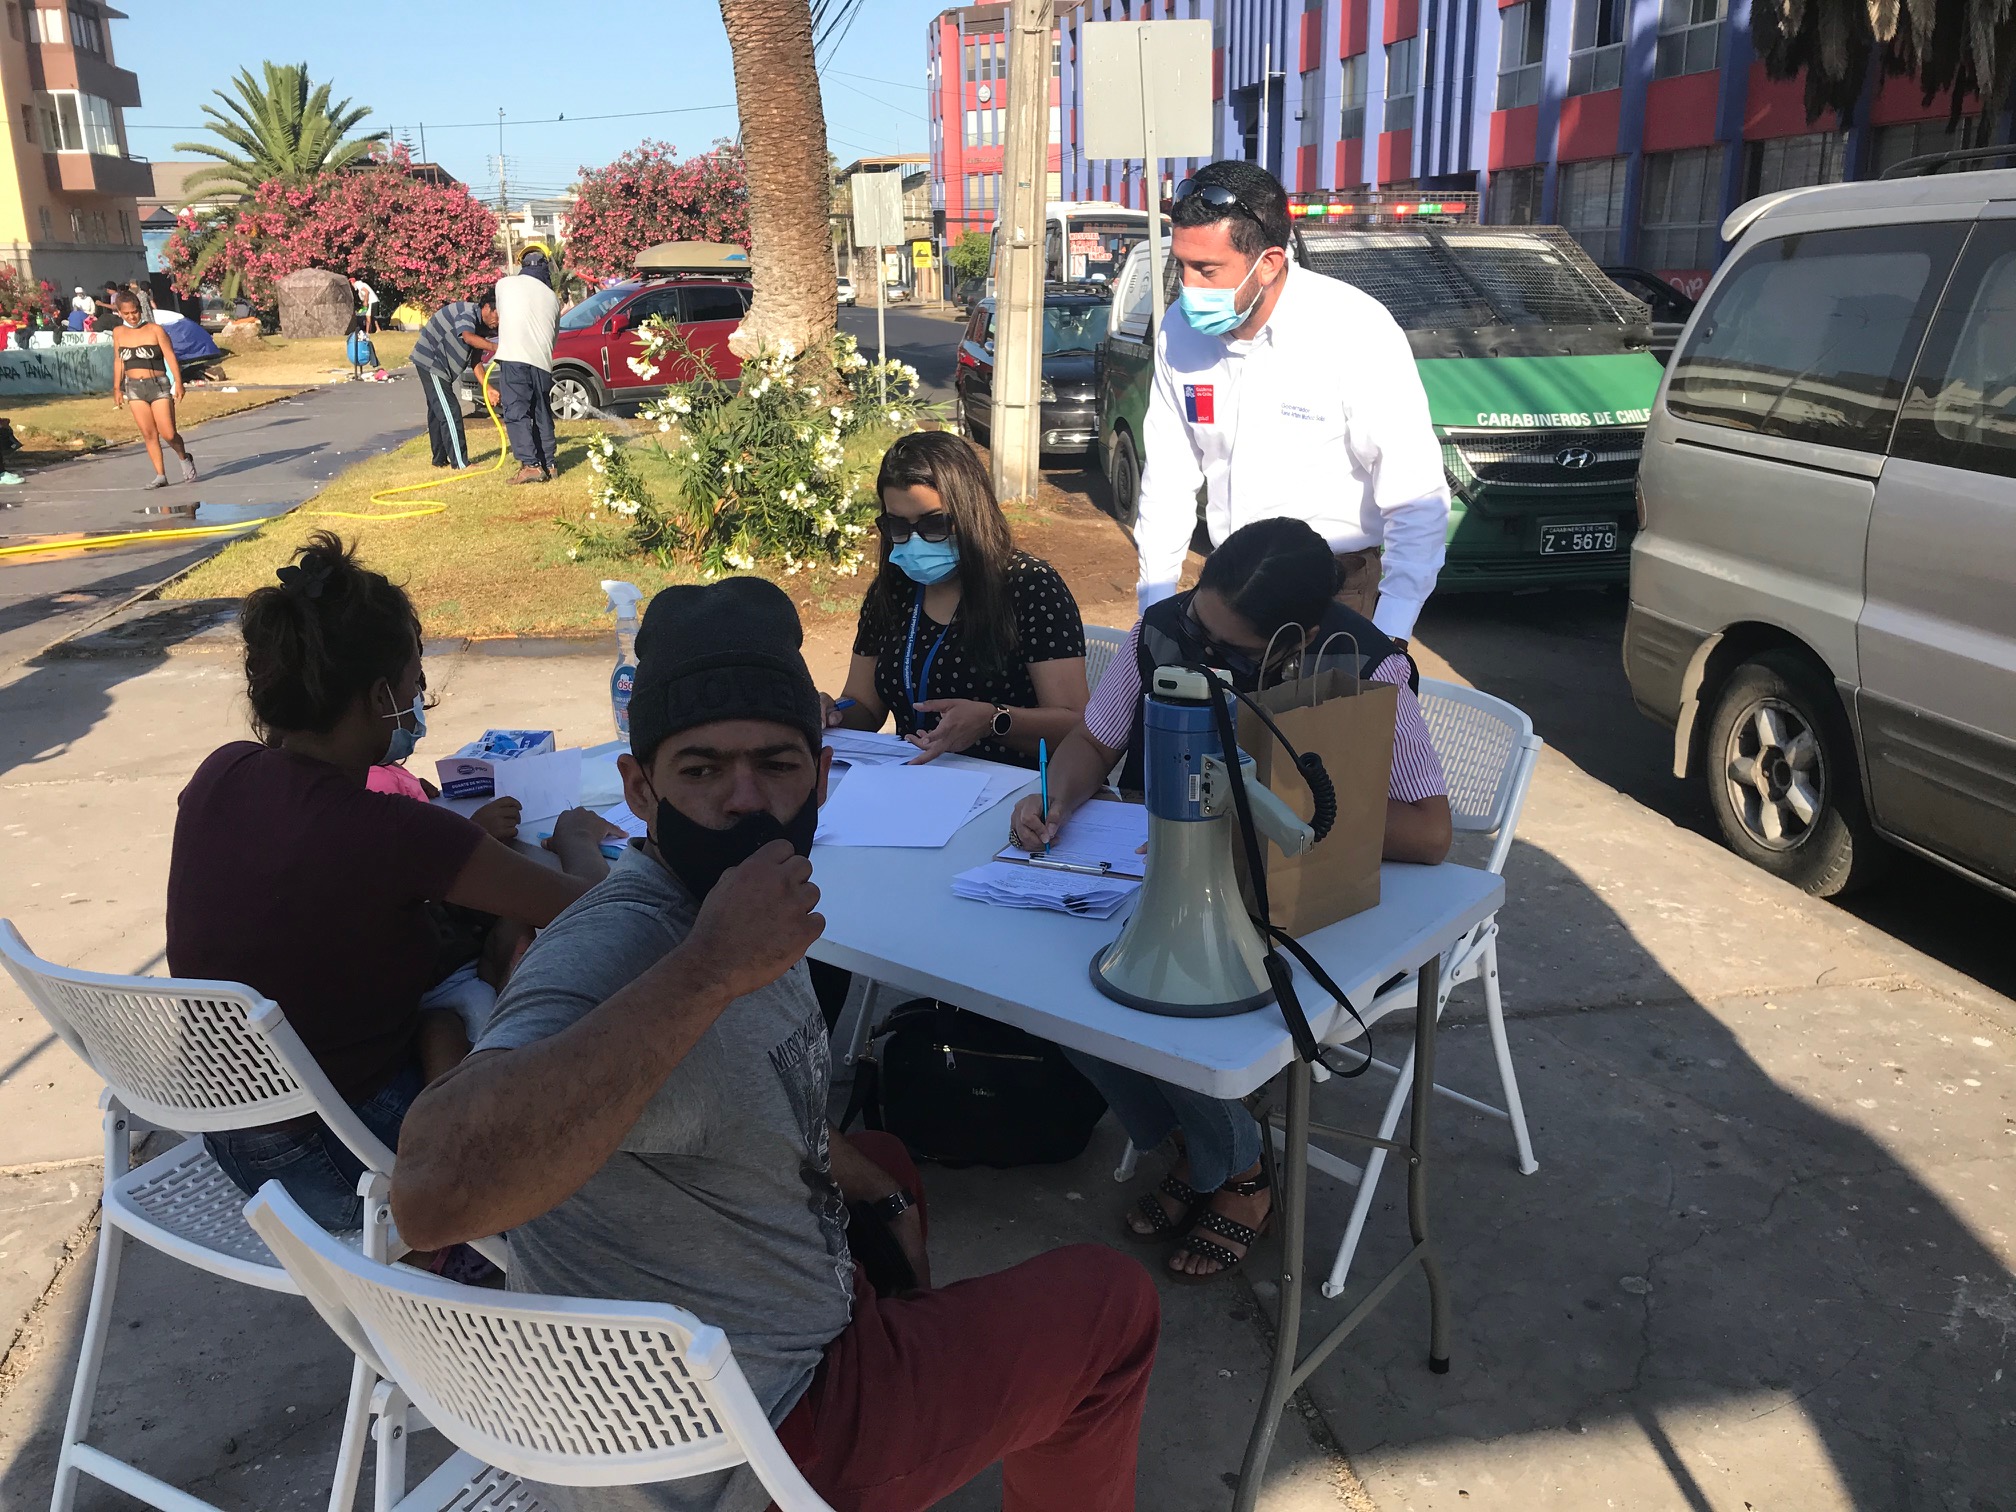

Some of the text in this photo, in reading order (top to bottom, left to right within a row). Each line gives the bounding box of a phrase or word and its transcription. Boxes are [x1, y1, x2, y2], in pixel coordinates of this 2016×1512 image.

[1477, 412, 1592, 427] CARABINEROS
[1594, 411, 1615, 425] DE
[1544, 532, 1614, 552] Z 5679
